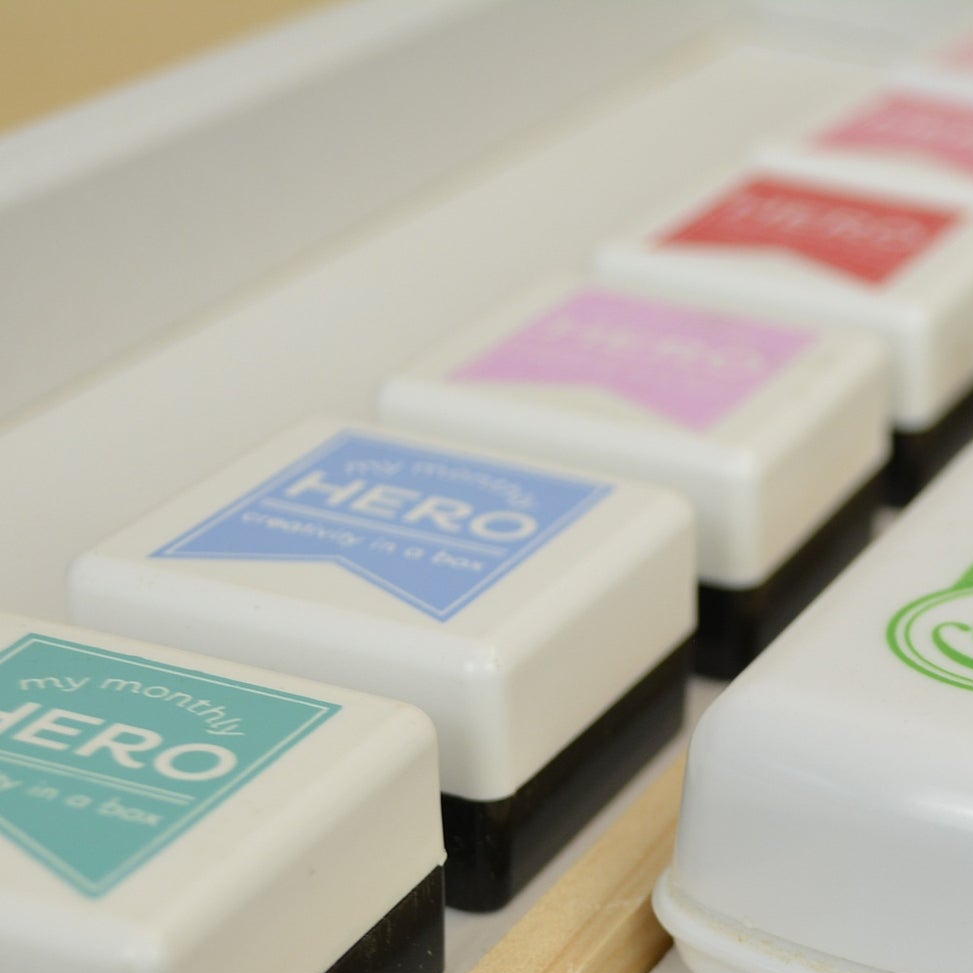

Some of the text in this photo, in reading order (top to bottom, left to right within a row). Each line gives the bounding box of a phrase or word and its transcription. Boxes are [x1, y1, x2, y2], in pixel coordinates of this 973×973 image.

[282, 469, 540, 543] HERO
[239, 509, 485, 574] creativity in a box
[16, 675, 246, 737] my monthly
[24, 778, 60, 800] in
[62, 792, 94, 810] a
[95, 795, 164, 827] box
